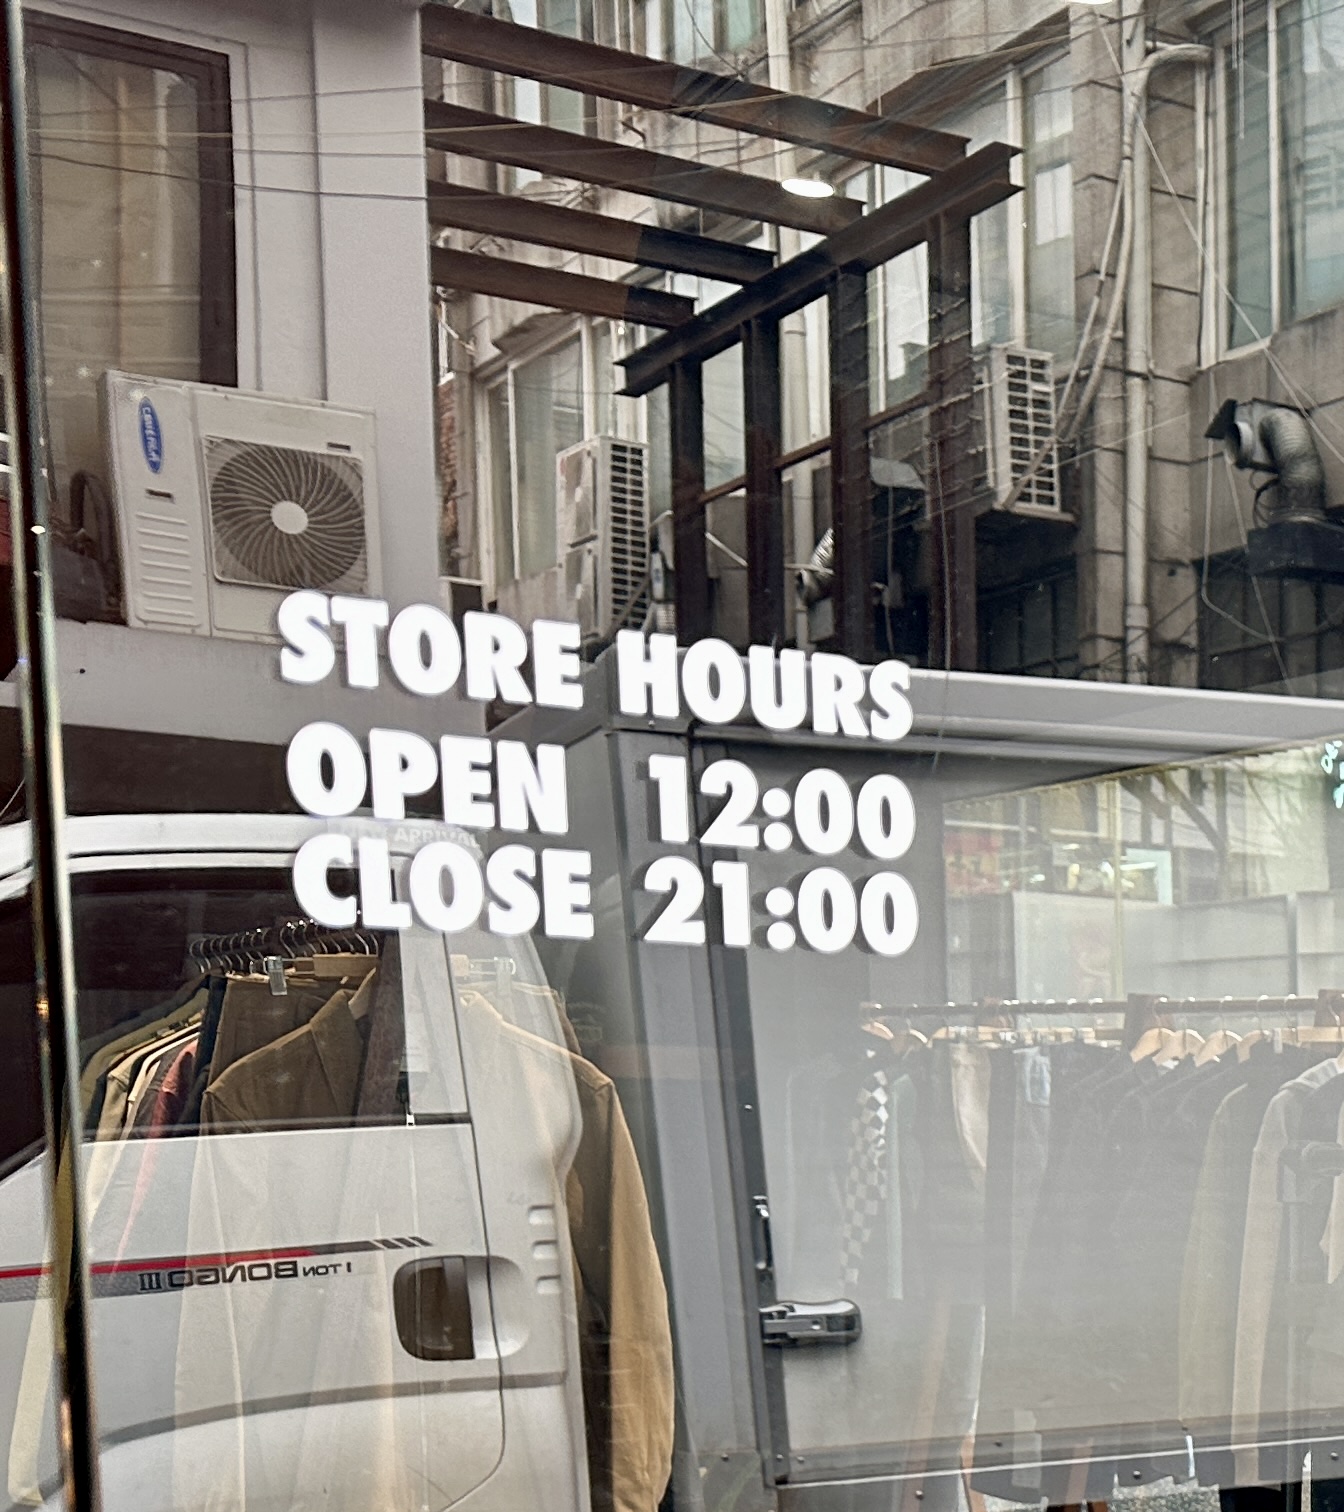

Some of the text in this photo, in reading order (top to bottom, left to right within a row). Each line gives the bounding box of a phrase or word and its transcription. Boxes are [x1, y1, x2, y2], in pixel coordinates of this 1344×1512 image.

[275, 588, 914, 742] STORE HOURS
[285, 721, 916, 861] OPEN 12:00
[292, 833, 920, 957] CLOSE 21:00
